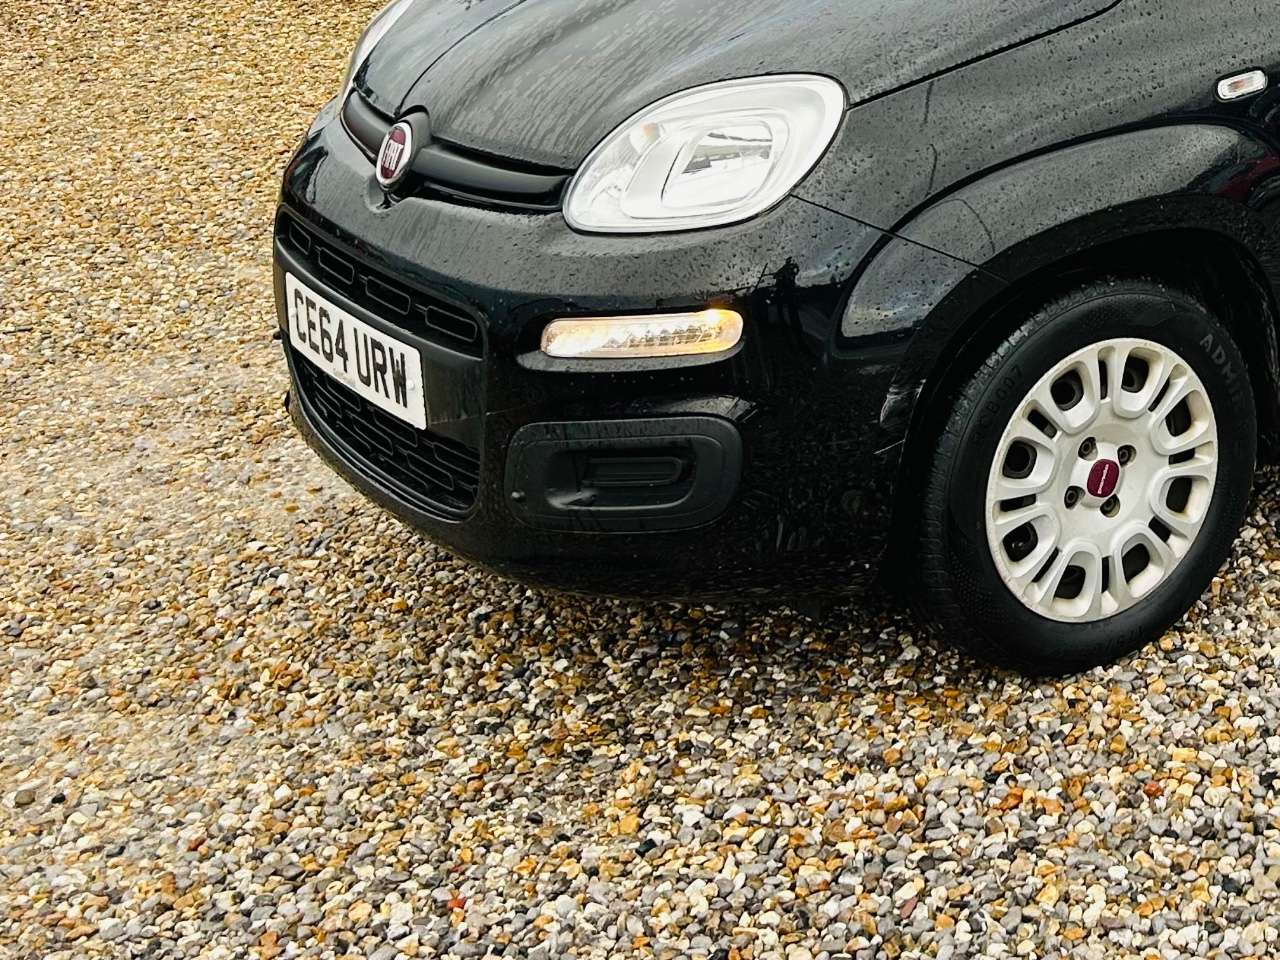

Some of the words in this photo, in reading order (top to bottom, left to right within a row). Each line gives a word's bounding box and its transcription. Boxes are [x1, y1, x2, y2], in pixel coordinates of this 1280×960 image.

[381, 139, 404, 171] FIAT
[294, 288, 349, 373] CE64
[353, 327, 408, 409] URW
